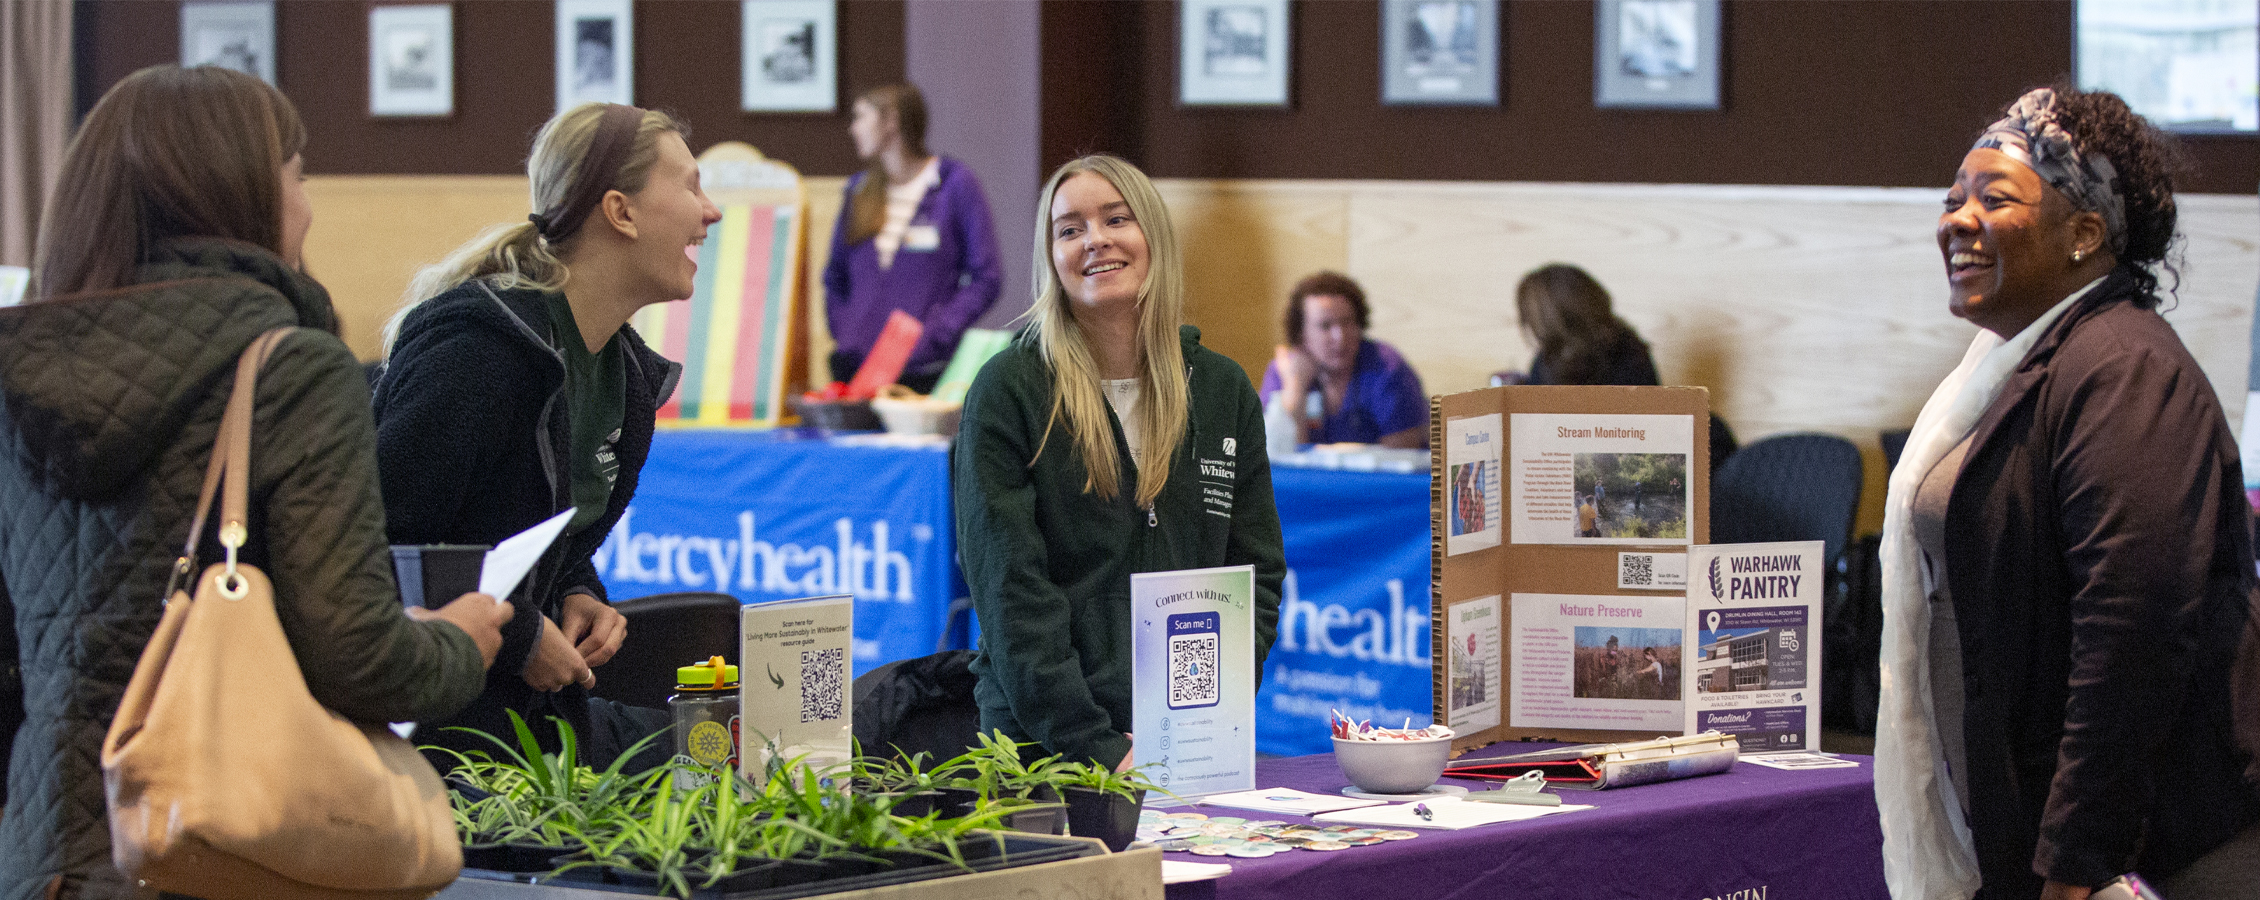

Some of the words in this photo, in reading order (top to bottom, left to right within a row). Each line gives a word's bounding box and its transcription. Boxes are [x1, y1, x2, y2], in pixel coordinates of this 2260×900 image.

[1557, 426, 1591, 439] Stream
[1594, 426, 1646, 441] Monitoring
[1200, 458, 1226, 467] University
[1730, 554, 1802, 574] WARHAWK
[1730, 575, 1802, 600] PANTRY
[1155, 590, 1195, 608] Connect
[1196, 588, 1217, 601] with
[1217, 592, 1232, 604] us!
[1559, 603, 1594, 617] Nature
[1598, 604, 1643, 618] Preserve
[782, 620, 794, 628] Scan
[1280, 567, 1432, 669] healt
[1174, 620, 1192, 630] Scan
[1193, 620, 1205, 628] me
[764, 631, 778, 639] More
[779, 628, 810, 638] Sustainably
[780, 639, 801, 647] resource
[801, 638, 815, 646] guide
[1707, 710, 1752, 724] Donations?
[693, 725, 703, 734] NO
[1206, 771, 1223, 779] powerful
[1223, 770, 1240, 778] podcast
